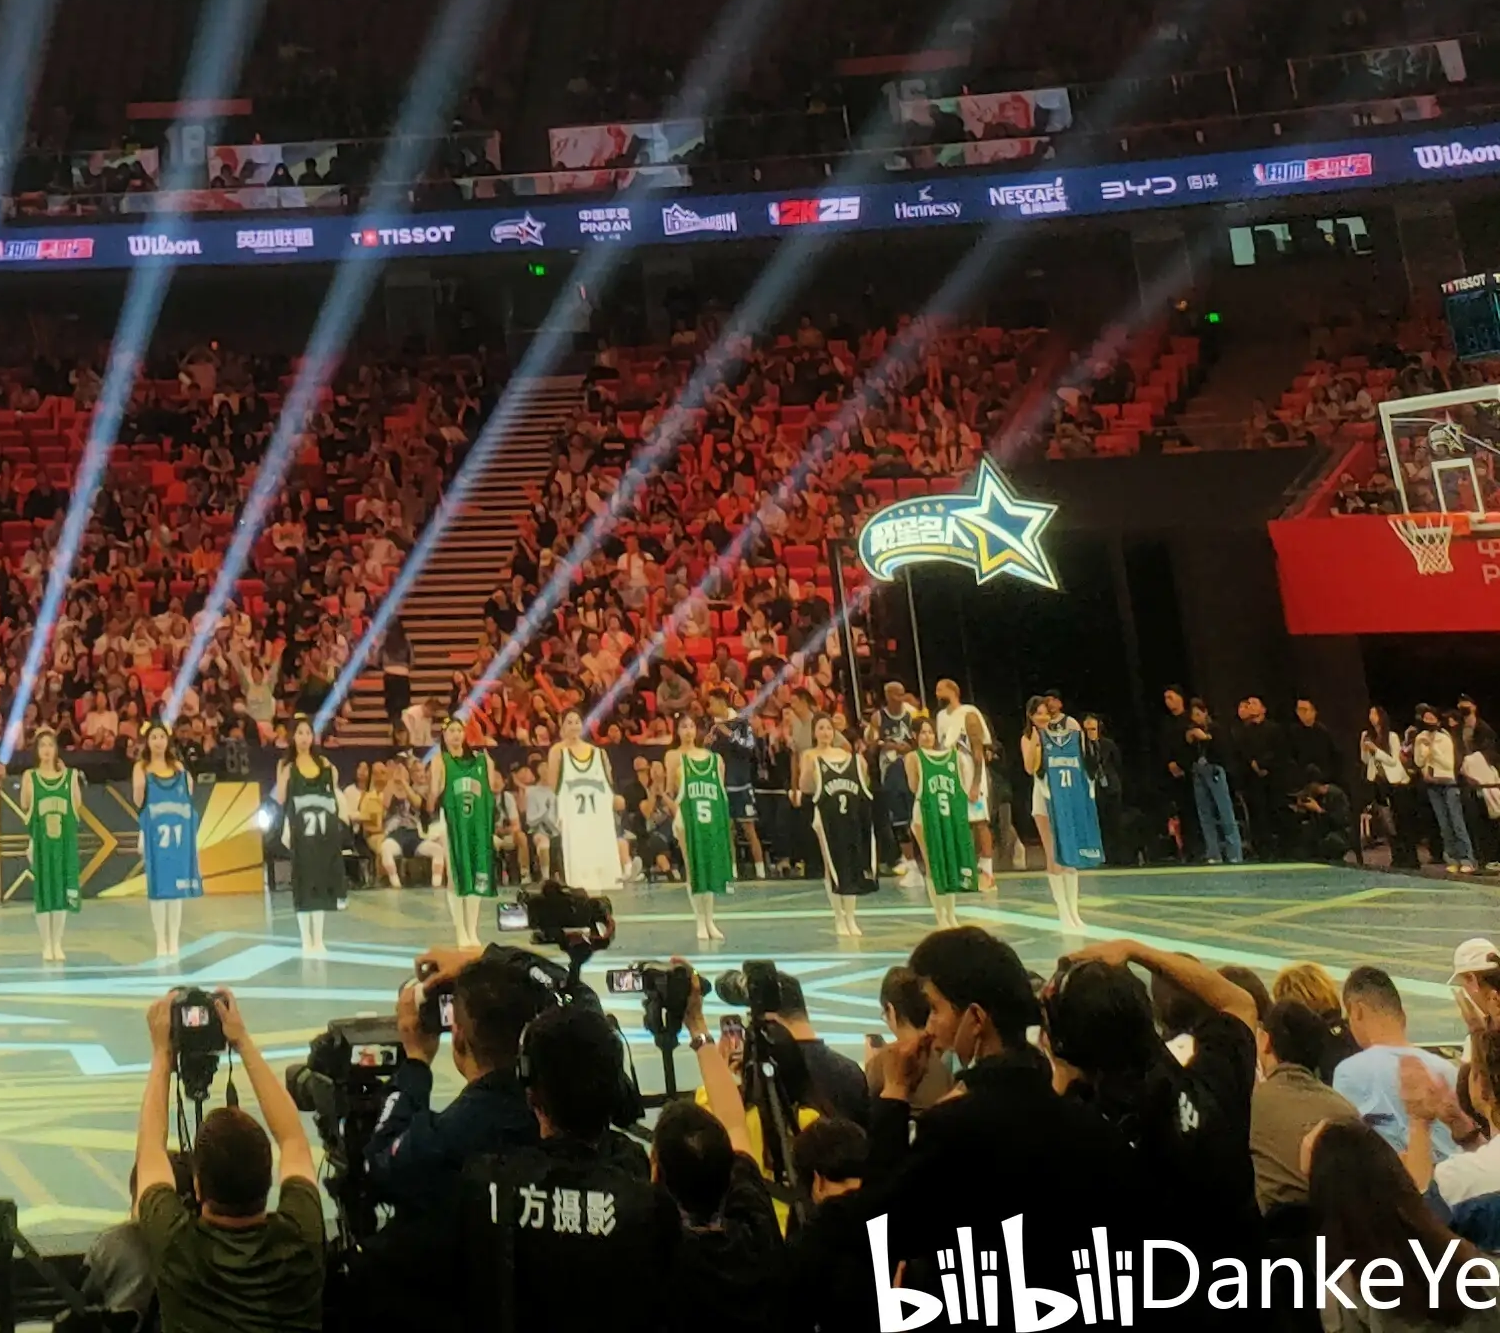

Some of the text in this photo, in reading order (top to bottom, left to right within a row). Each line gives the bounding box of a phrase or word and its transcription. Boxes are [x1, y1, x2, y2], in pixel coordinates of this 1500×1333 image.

[1413, 141, 1500, 170] Wilson
[1100, 176, 1178, 200] BYD
[778, 196, 861, 226] 2K25
[895, 201, 962, 220] Hennessy
[128, 236, 202, 256] Wilson
[378, 225, 456, 245] TISSOT
[575, 792, 597, 815] 21
[696, 800, 712, 824] 5
[937, 792, 950, 817] 5
[304, 810, 327, 836] 21
[157, 824, 182, 848] 21
[488, 1181, 617, 1237] 方摄影
